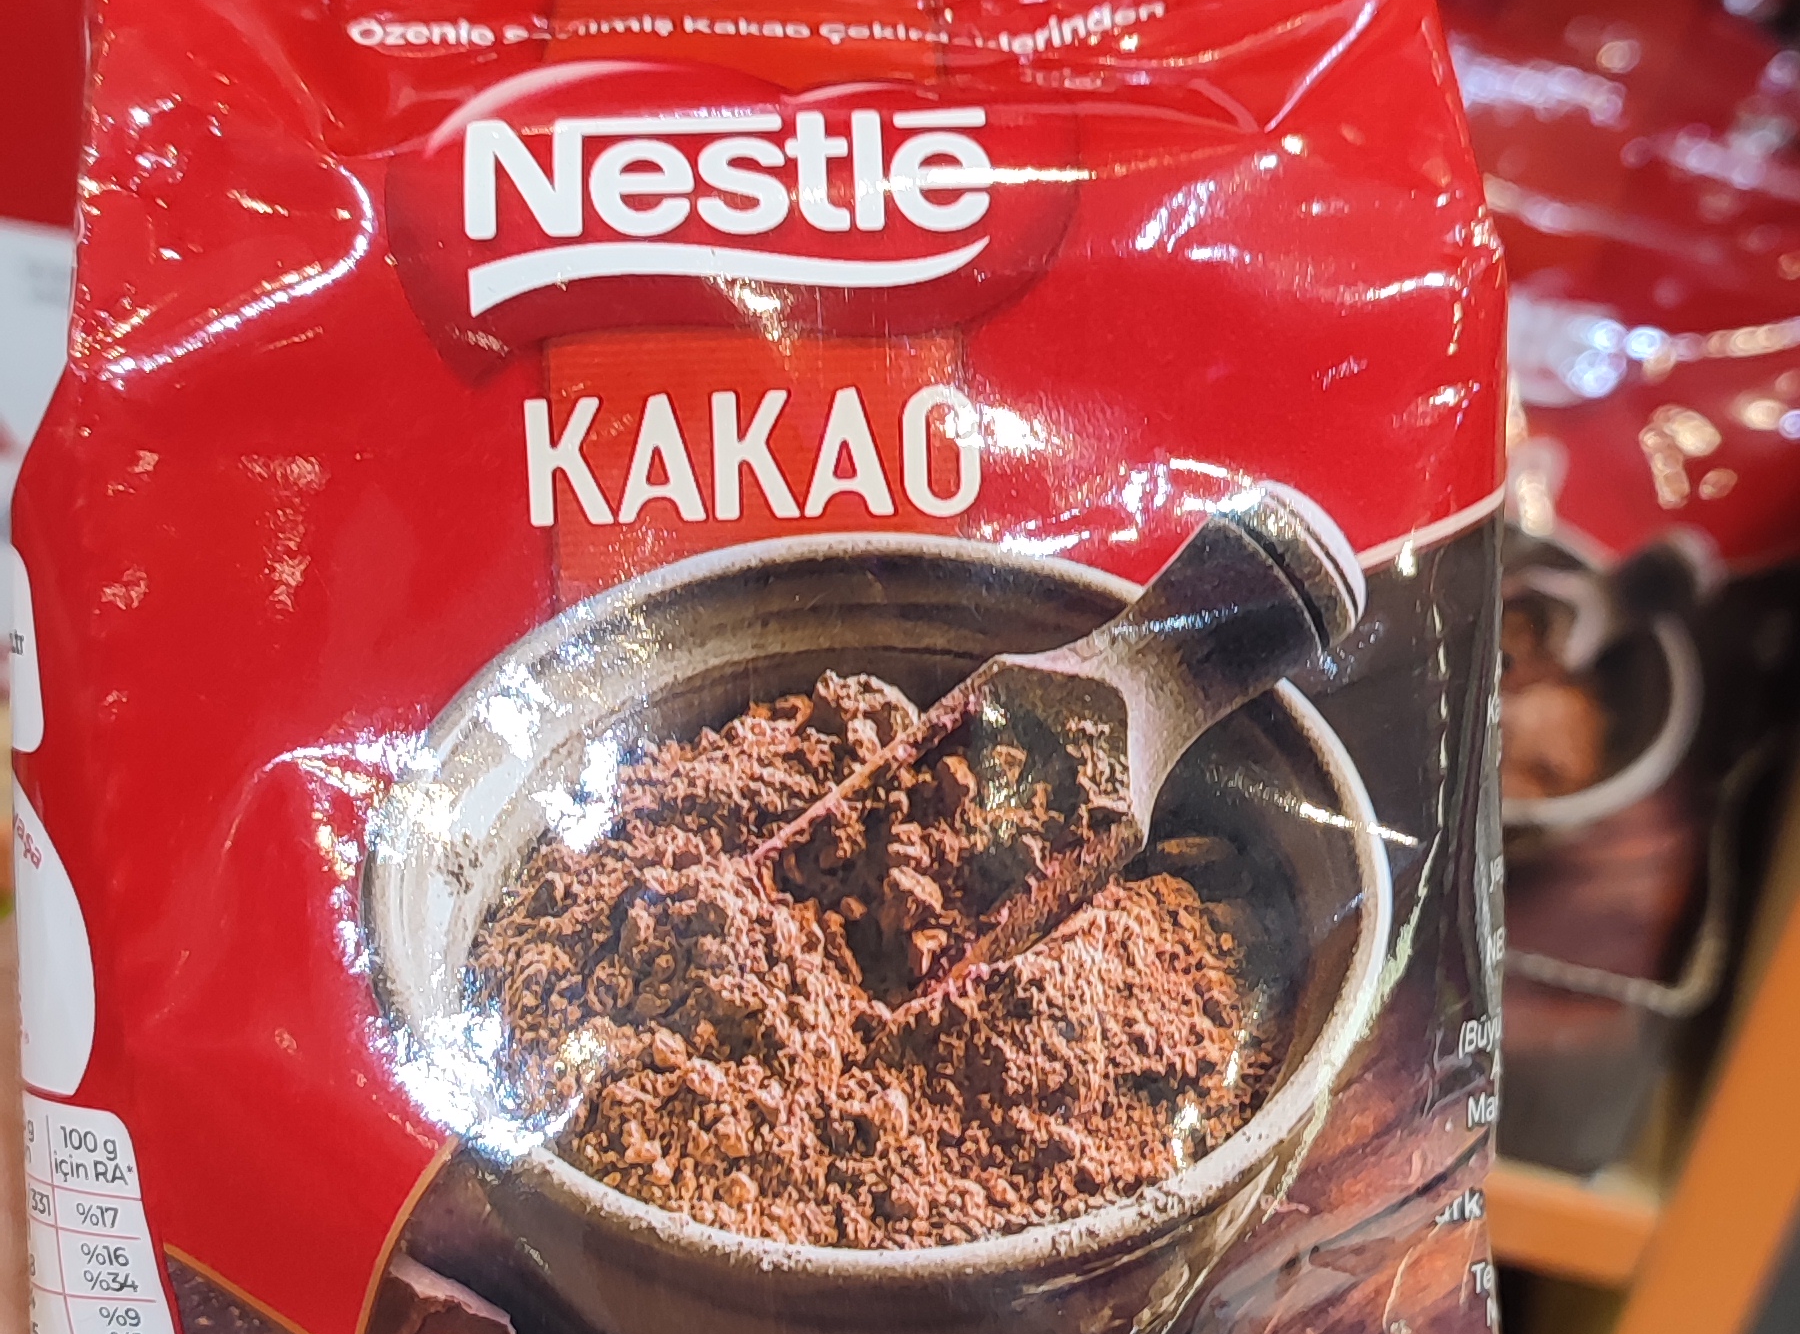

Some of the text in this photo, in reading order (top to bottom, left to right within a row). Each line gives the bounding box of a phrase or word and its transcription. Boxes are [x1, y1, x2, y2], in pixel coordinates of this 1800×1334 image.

[522, 384, 982, 528] KAKAO
[59, 1124, 119, 1162] 100 g
[53, 1150, 89, 1183] için
[75, 1202, 119, 1229] %17
[80, 1242, 130, 1267] %16
[83, 1269, 139, 1293] %34
[98, 1306, 142, 1328] %9
